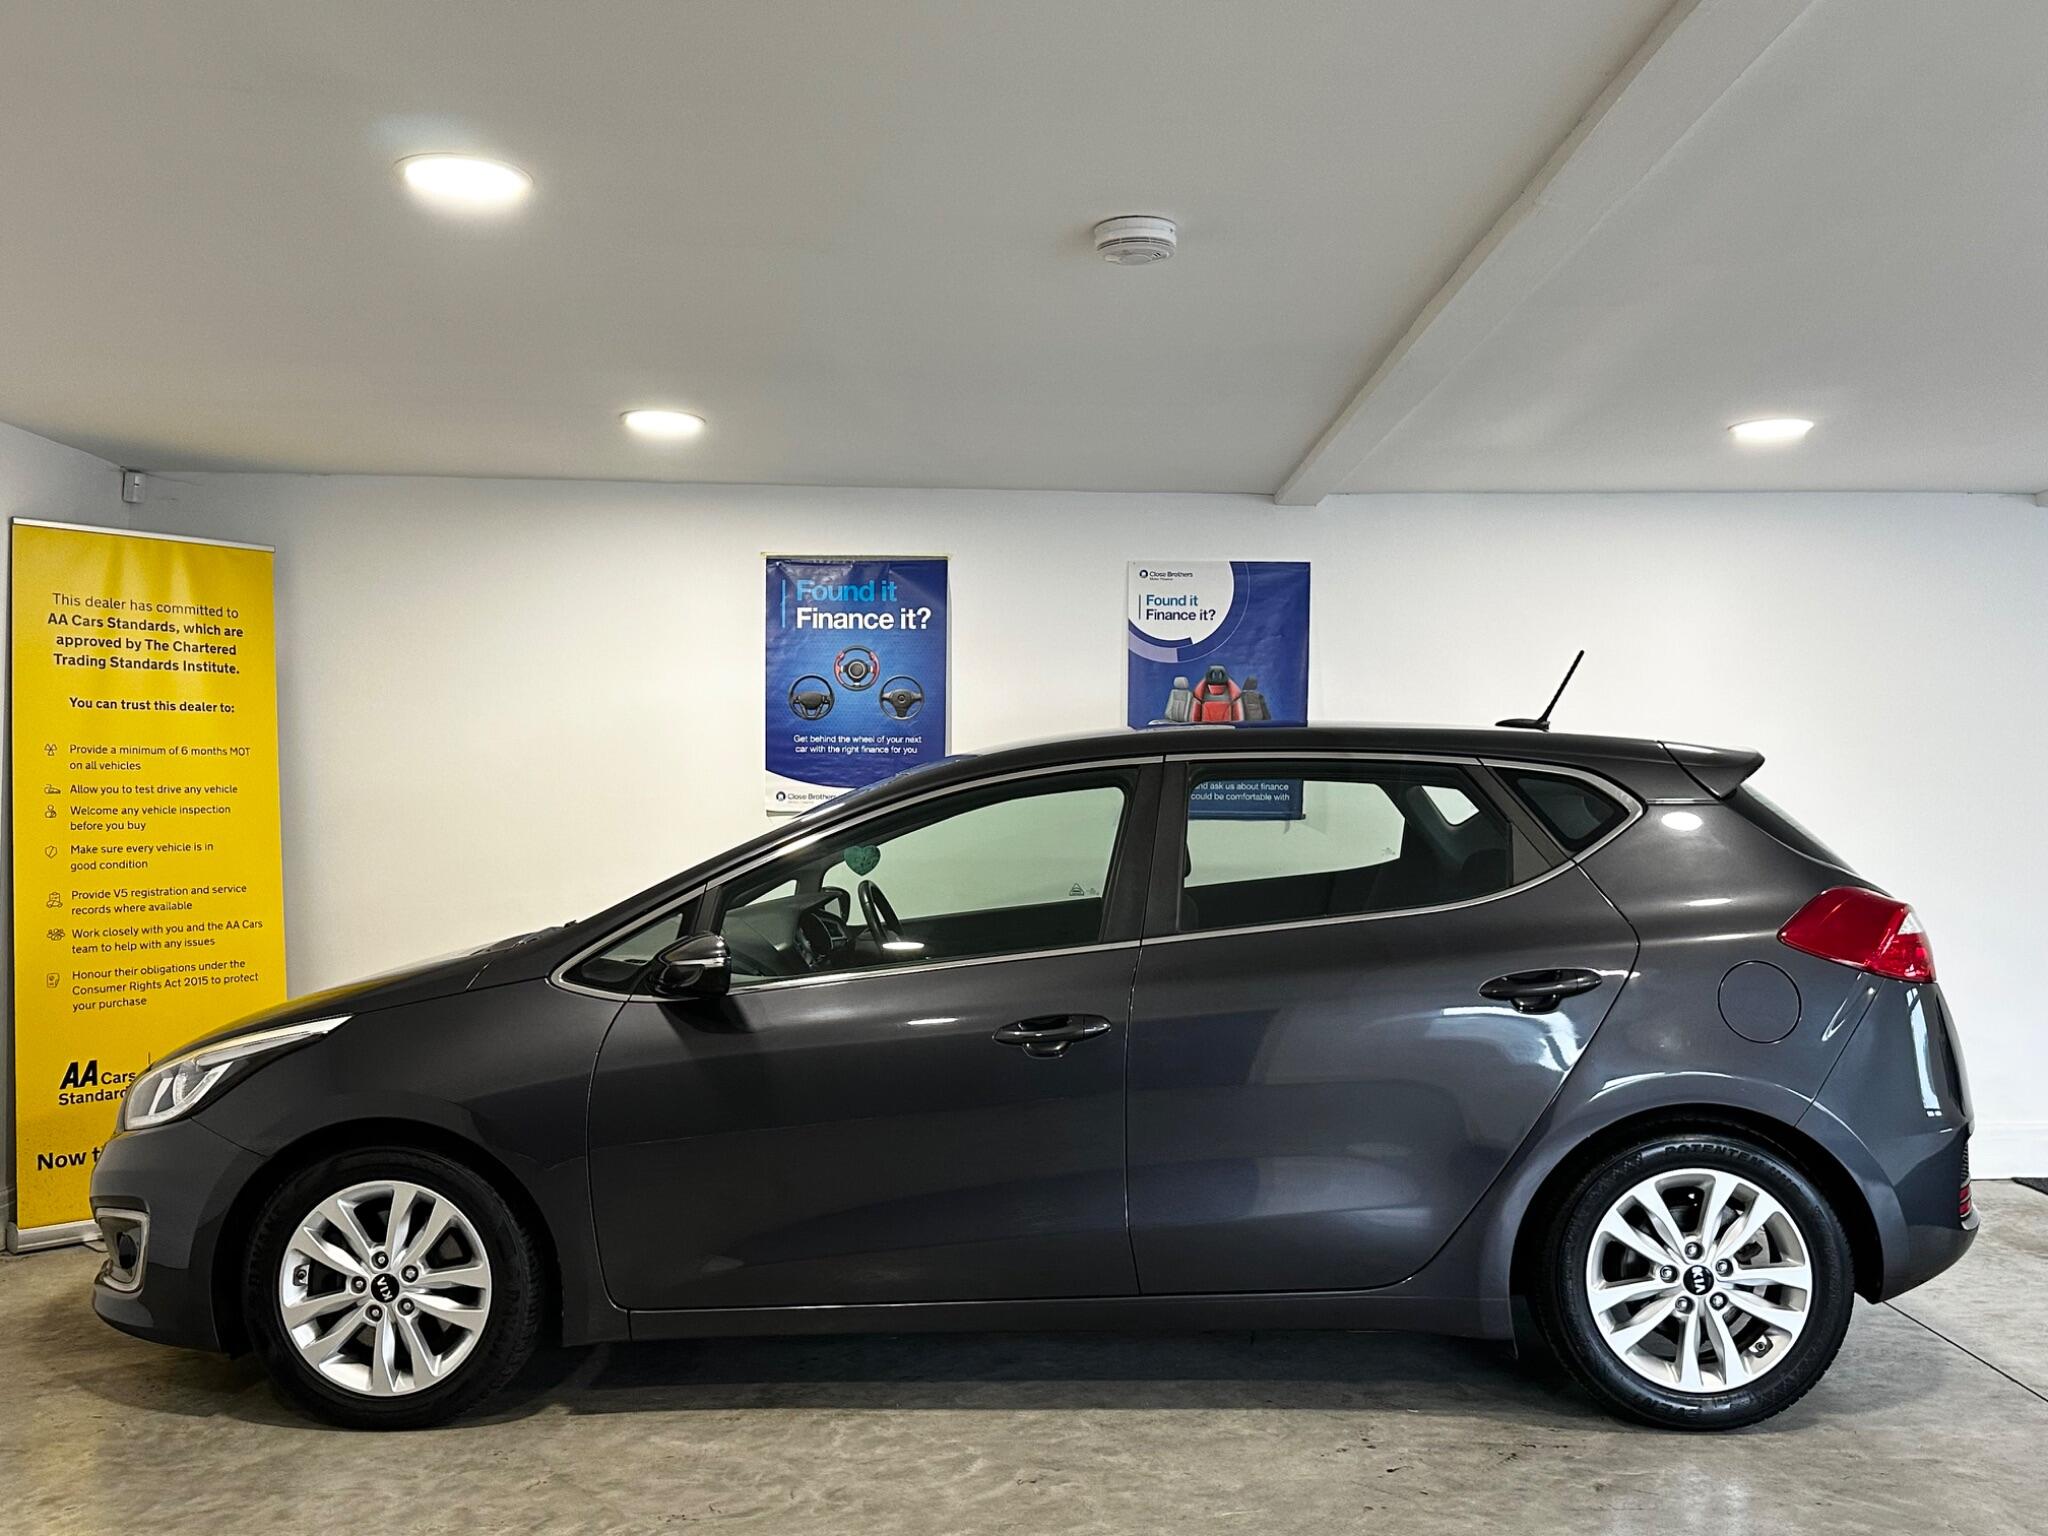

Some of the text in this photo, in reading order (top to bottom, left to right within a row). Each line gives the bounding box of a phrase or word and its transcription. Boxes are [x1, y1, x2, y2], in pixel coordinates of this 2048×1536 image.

[796, 580, 898, 603] Found it
[52, 593, 239, 619] This dealer has committed to
[1146, 594, 1198, 606] Found it
[797, 607, 931, 630] Finance it?
[1146, 608, 1216, 621] Finance it?
[48, 613, 243, 637] AA Cars Standards, which are
[56, 636, 236, 655] approved by The Chartered
[53, 653, 240, 674] Trading Standards Institute.
[69, 697, 234, 713] You can trust this dealer to:
[794, 735, 808, 743] Get
[810, 735, 836, 743] behind
[852, 735, 875, 743] wheel
[876, 735, 885, 743] of
[886, 737, 904, 745] your
[70, 744, 108, 754] Provide
[119, 746, 166, 755] minimum
[168, 746, 179, 755] of
[181, 746, 188, 755] 6
[191, 747, 228, 755] months
[229, 747, 251, 756] MOT
[827, 745, 841, 753] the
[842, 745, 859, 755] right
[861, 745, 889, 753] finance
[890, 745, 901, 754] for
[903, 747, 918, 755] you
[69, 761, 142, 770] on all vehicles
[70, 784, 238, 796] Allow you to test drive any vehicle
[1260, 783, 1289, 791] finance
[1214, 791, 1224, 800] be
[1225, 793, 1272, 801] comfortable
[1273, 793, 1290, 801] with
[70, 805, 231, 817] Welcome any vehicle inspection
[70, 821, 146, 832] before you buy
[71, 842, 214, 854] Make sure every vehicle is in
[70, 859, 148, 872] good condition
[71, 885, 247, 900] Provide V5 registration and service
[71, 901, 193, 915] records where available
[71, 920, 263, 939] Work closely with you and the AA Cars
[72, 938, 216, 954] team to help with any issues
[72, 960, 246, 980] Honour their obligations under the
[72, 973, 258, 995] Consumer Rights Act 2015 to protect
[72, 997, 147, 1013] your purchase
[59, 1060, 136, 1090] AA Cars
[37, 1151, 87, 1171] Now
